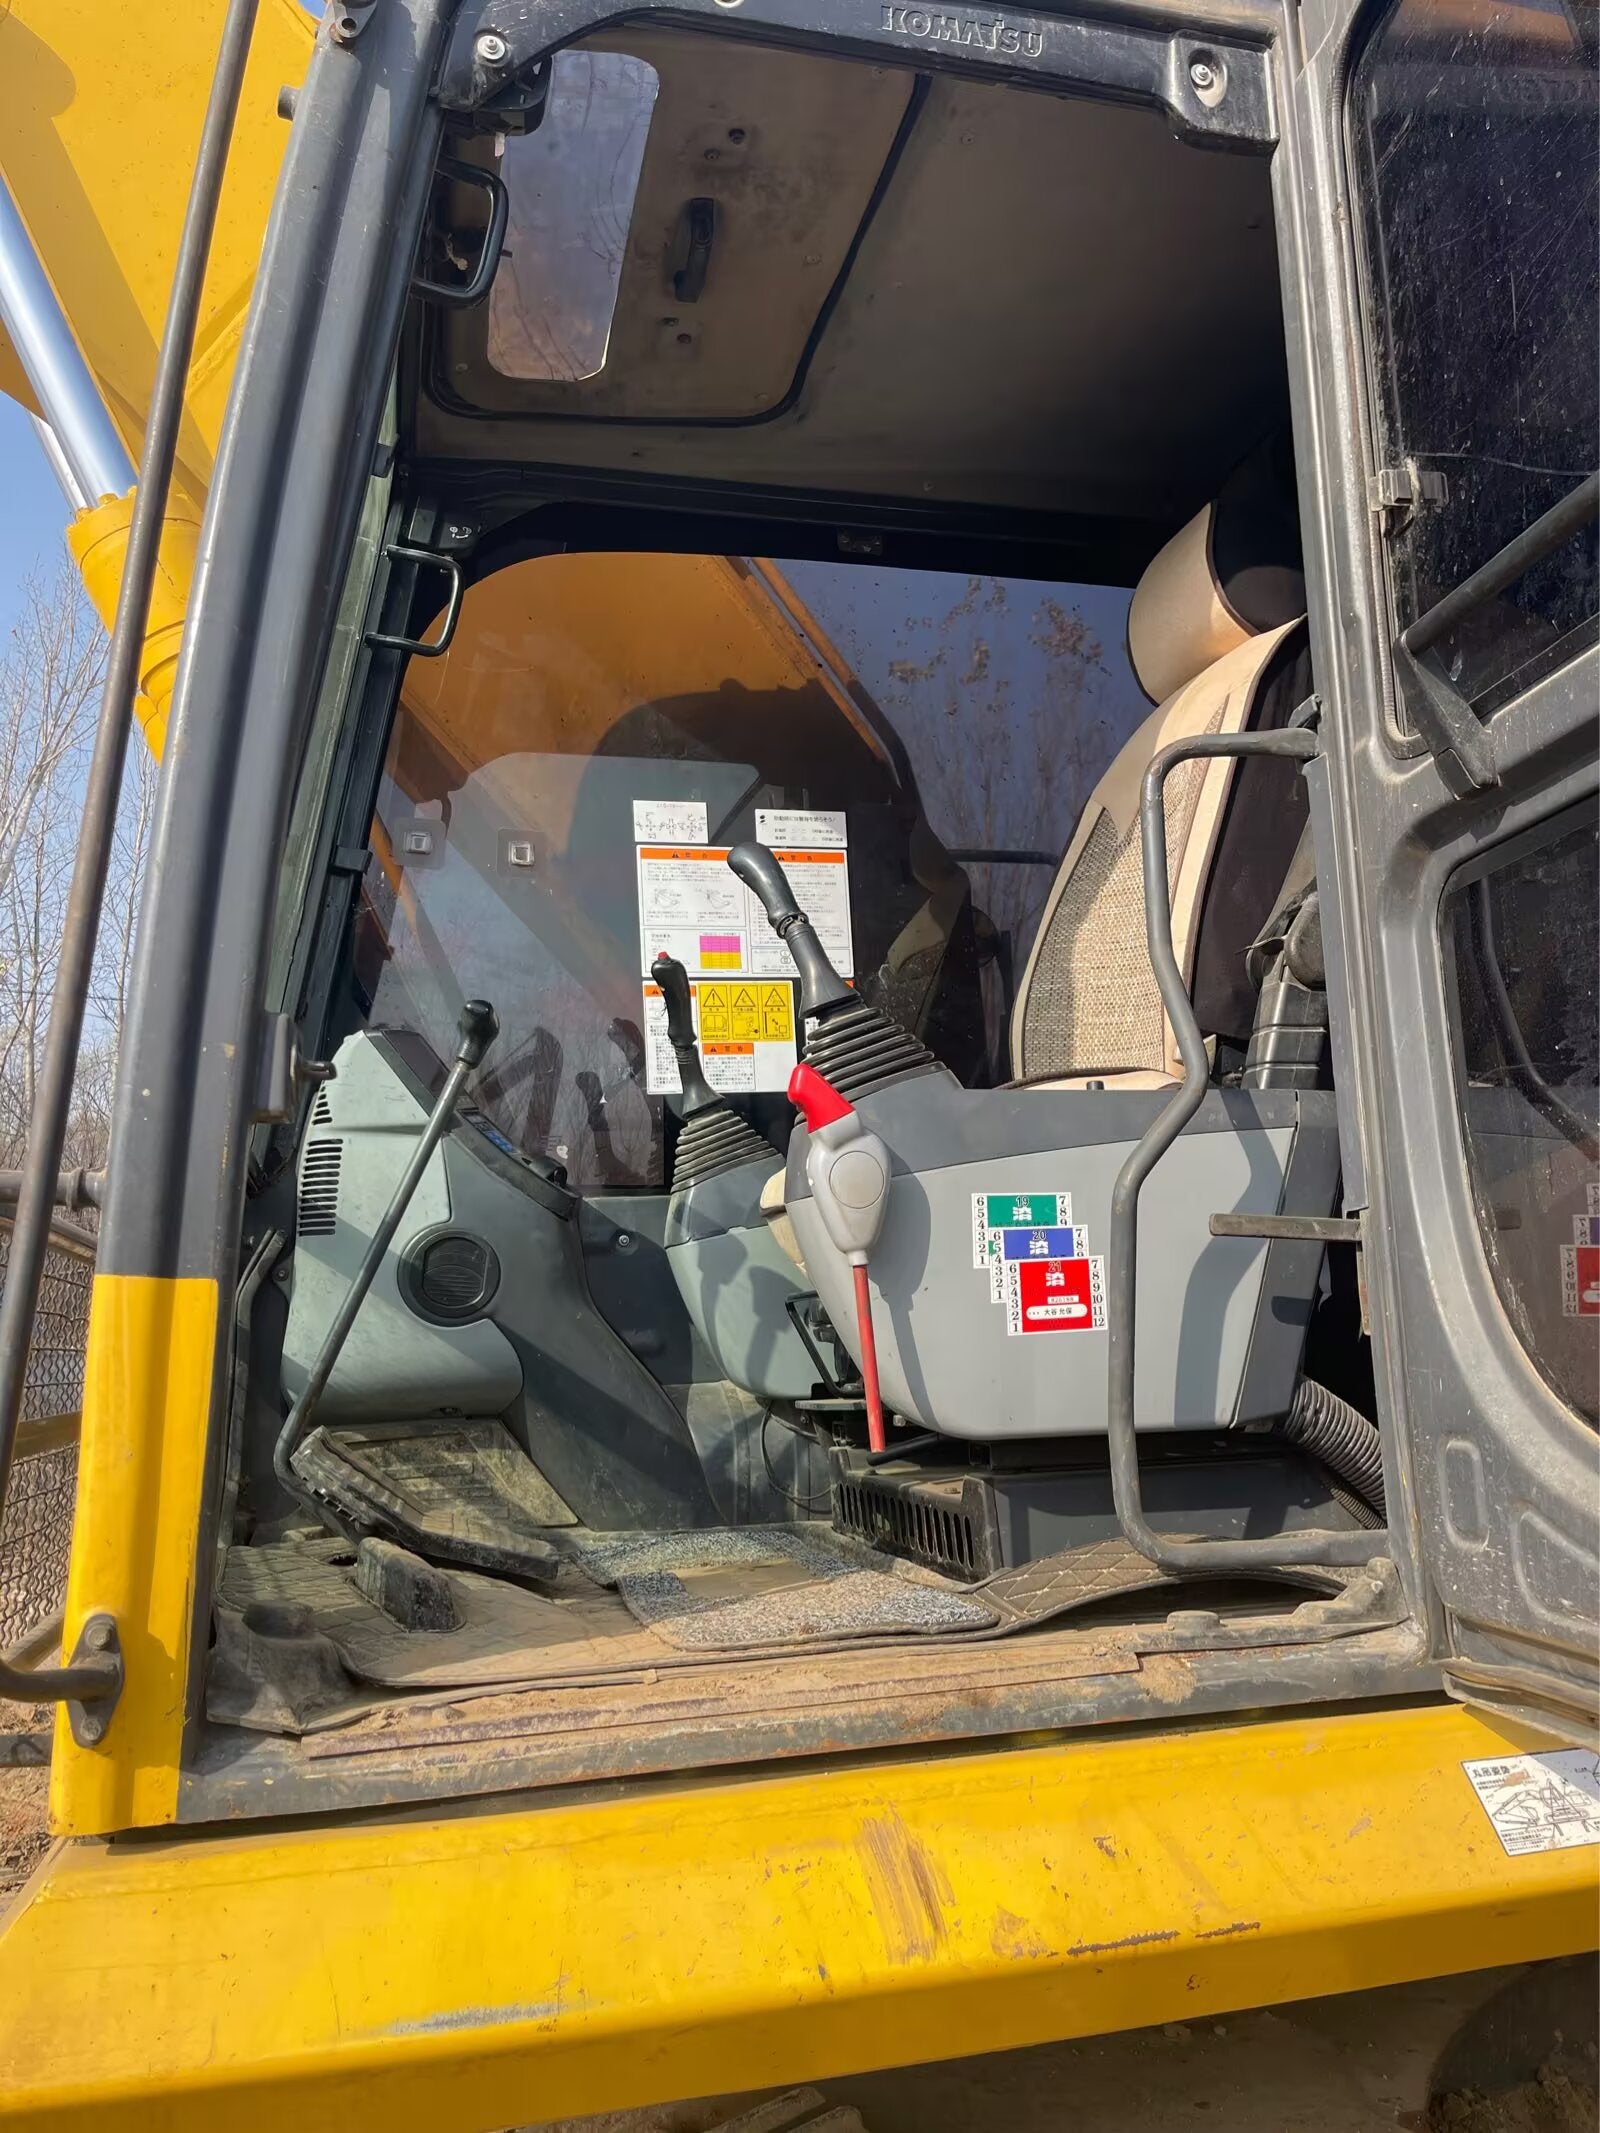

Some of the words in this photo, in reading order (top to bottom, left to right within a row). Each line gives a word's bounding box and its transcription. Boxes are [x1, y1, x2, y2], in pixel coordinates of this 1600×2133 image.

[881, 5, 1043, 57] KOMATSU
[976, 1196, 985, 1207] 6
[1016, 1196, 1029, 1207] 19
[1058, 1195, 1067, 1205] 7
[977, 1208, 985, 1219] 5
[1059, 1207, 1067, 1217] 8
[977, 1219, 985, 1230] 4
[978, 1231, 986, 1242] 3
[993, 1231, 1001, 1242] 6
[1032, 1230, 1046, 1241] 20
[1075, 1228, 1083, 1238] 7
[978, 1243, 986, 1254] 2
[994, 1242, 1002, 1253] 5
[1076, 1239, 1084, 1250] 8
[979, 1255, 985, 1265] 1
[994, 1254, 1002, 1265] 4
[1091, 1259, 1099, 1269] 7
[995, 1266, 1003, 1276] 3
[1009, 1263, 1017, 1274] 6
[1048, 1260, 1062, 1273] 21
[1010, 1275, 1018, 1286] 5
[1092, 1271, 1100, 1281] 8
[995, 1278, 1003, 1288] 2
[1092, 1282, 1100, 1292] 9
[996, 1290, 1002, 1300] 1
[1010, 1287, 1018, 1297] 4
[1011, 1299, 1019, 1309] 3
[1092, 1294, 1103, 1304] 10
[1011, 1311, 1019, 1321] 2
[1093, 1306, 1104, 1316] 11
[1094, 1317, 1105, 1327] 12
[1013, 1322, 1018, 1333] 1
